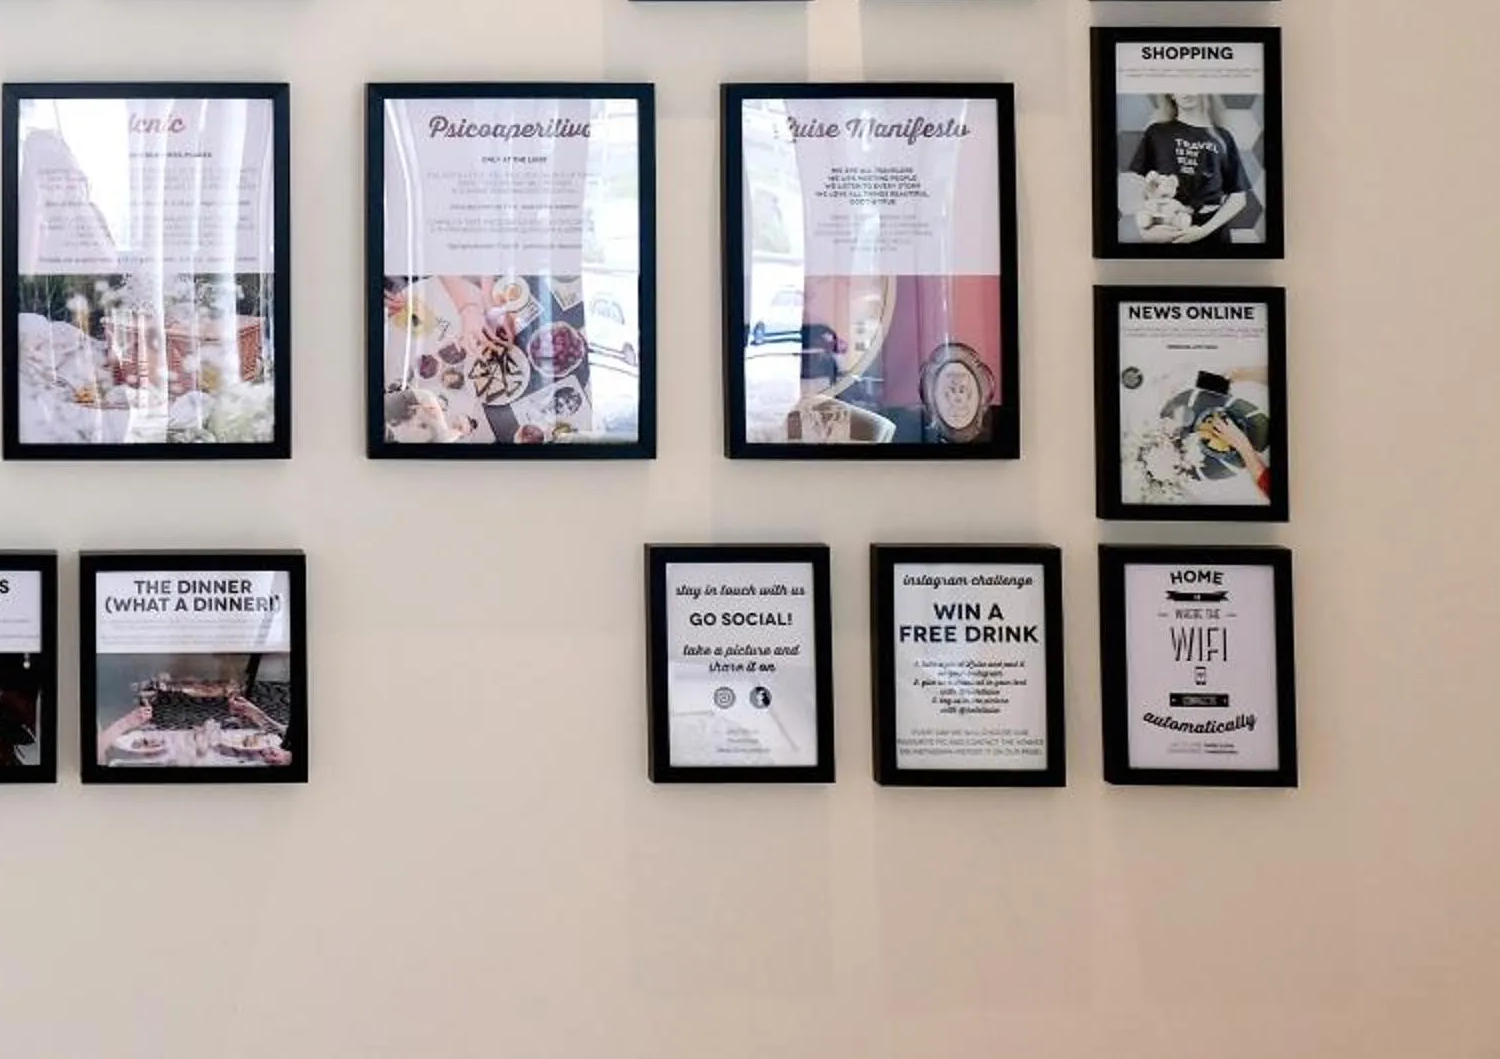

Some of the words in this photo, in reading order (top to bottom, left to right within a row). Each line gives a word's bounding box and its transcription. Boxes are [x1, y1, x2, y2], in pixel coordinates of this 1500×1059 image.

[1141, 46, 1234, 60] SHOPPING
[786, 115, 842, 144] uise
[1128, 305, 1182, 320] NEWS
[1185, 305, 1255, 320] ONLINE
[902, 574, 969, 590] instagram
[970, 574, 1033, 590] challenge
[1169, 569, 1224, 586] HOME
[133, 579, 172, 595] THE
[177, 579, 253, 595] DINNER
[104, 592, 171, 614] (WHAT
[173, 592, 189, 612] A
[933, 602, 981, 621] WIN
[987, 602, 1005, 621] A
[689, 612, 717, 627] GO
[721, 612, 793, 627] SOCIAL!
[899, 625, 957, 643] FREE
[965, 625, 1039, 644] DRINK
[1170, 626, 1228, 662] WIFI
[1142, 712, 1257, 734] automatically
